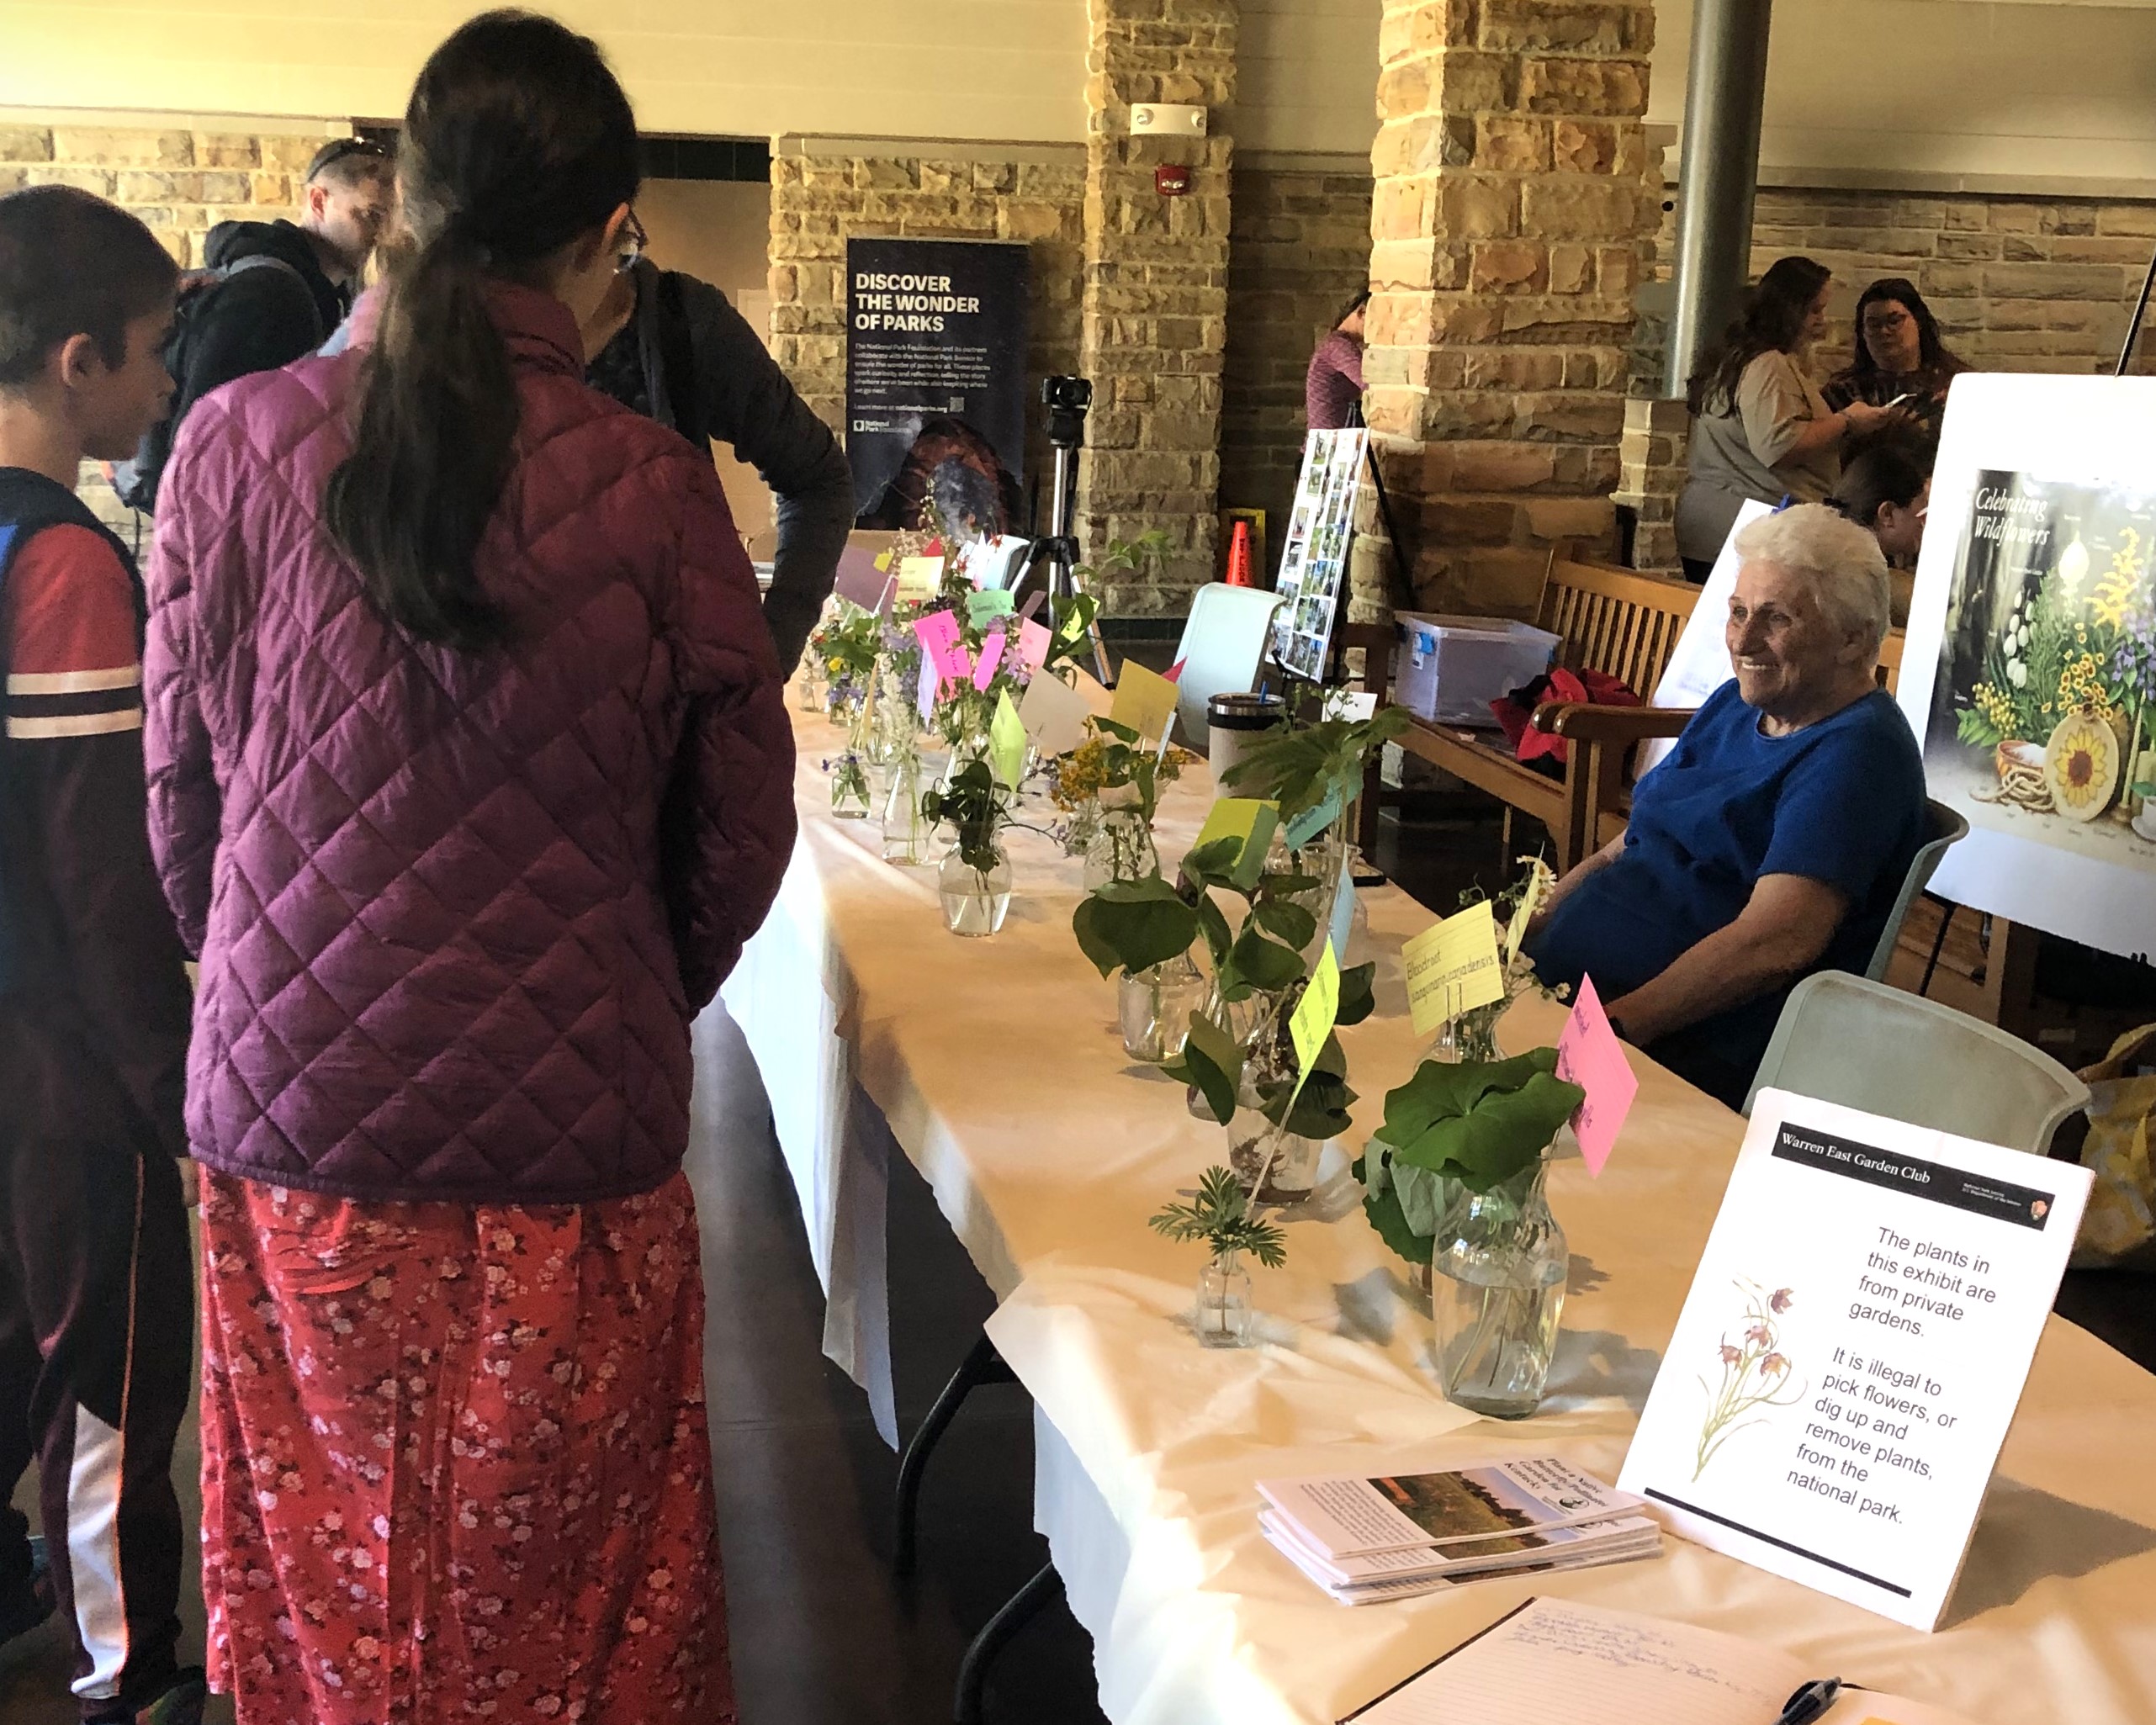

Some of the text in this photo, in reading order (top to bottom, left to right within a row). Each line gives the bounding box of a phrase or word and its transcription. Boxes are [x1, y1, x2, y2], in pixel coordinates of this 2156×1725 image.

[856, 273, 951, 293] DISCOVER
[856, 294, 979, 314] THE WONDER
[856, 314, 944, 332] OF PARKS
[1976, 487, 2047, 522] Celebrating
[1974, 515, 2050, 547] Wildflowers
[1783, 1133, 1930, 1183] Warren East Garden Club
[1879, 1226, 1989, 1273] The plants in
[1859, 1276, 1963, 1320] from private
[1868, 1252, 1995, 1302] this exhibit are
[1849, 1304, 1924, 1336] gardens.
[1833, 1347, 1941, 1395] It is illegal to
[1815, 1398, 1908, 1440] dig up and
[1823, 1375, 1957, 1427] pick flowers, or
[1797, 1443, 1867, 1481] from the
[1806, 1423, 1931, 1479] remove plants,
[1788, 1471, 1901, 1523] national park.
